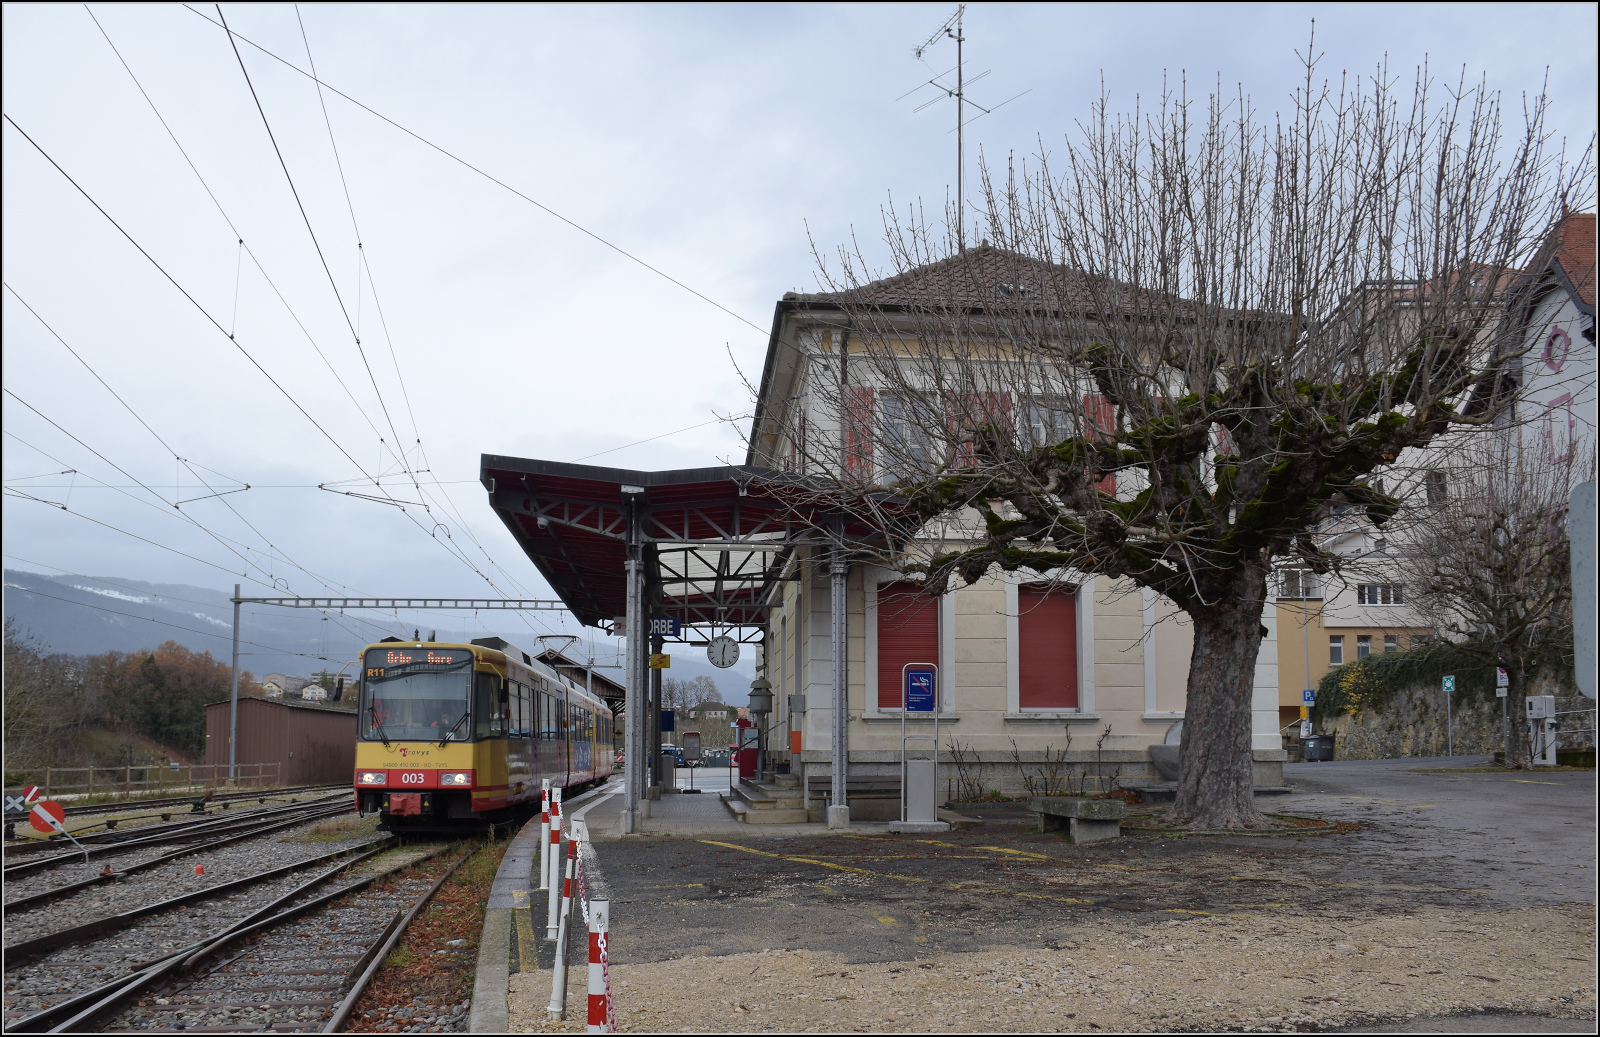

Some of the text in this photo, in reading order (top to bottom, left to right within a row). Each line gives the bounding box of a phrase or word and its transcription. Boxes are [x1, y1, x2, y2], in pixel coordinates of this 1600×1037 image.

[387, 651, 412, 664] Orbe
[427, 651, 453, 664] Gare
[367, 668, 384, 677] R11
[1305, 691, 1311, 700] P
[401, 773, 425, 784] 003
